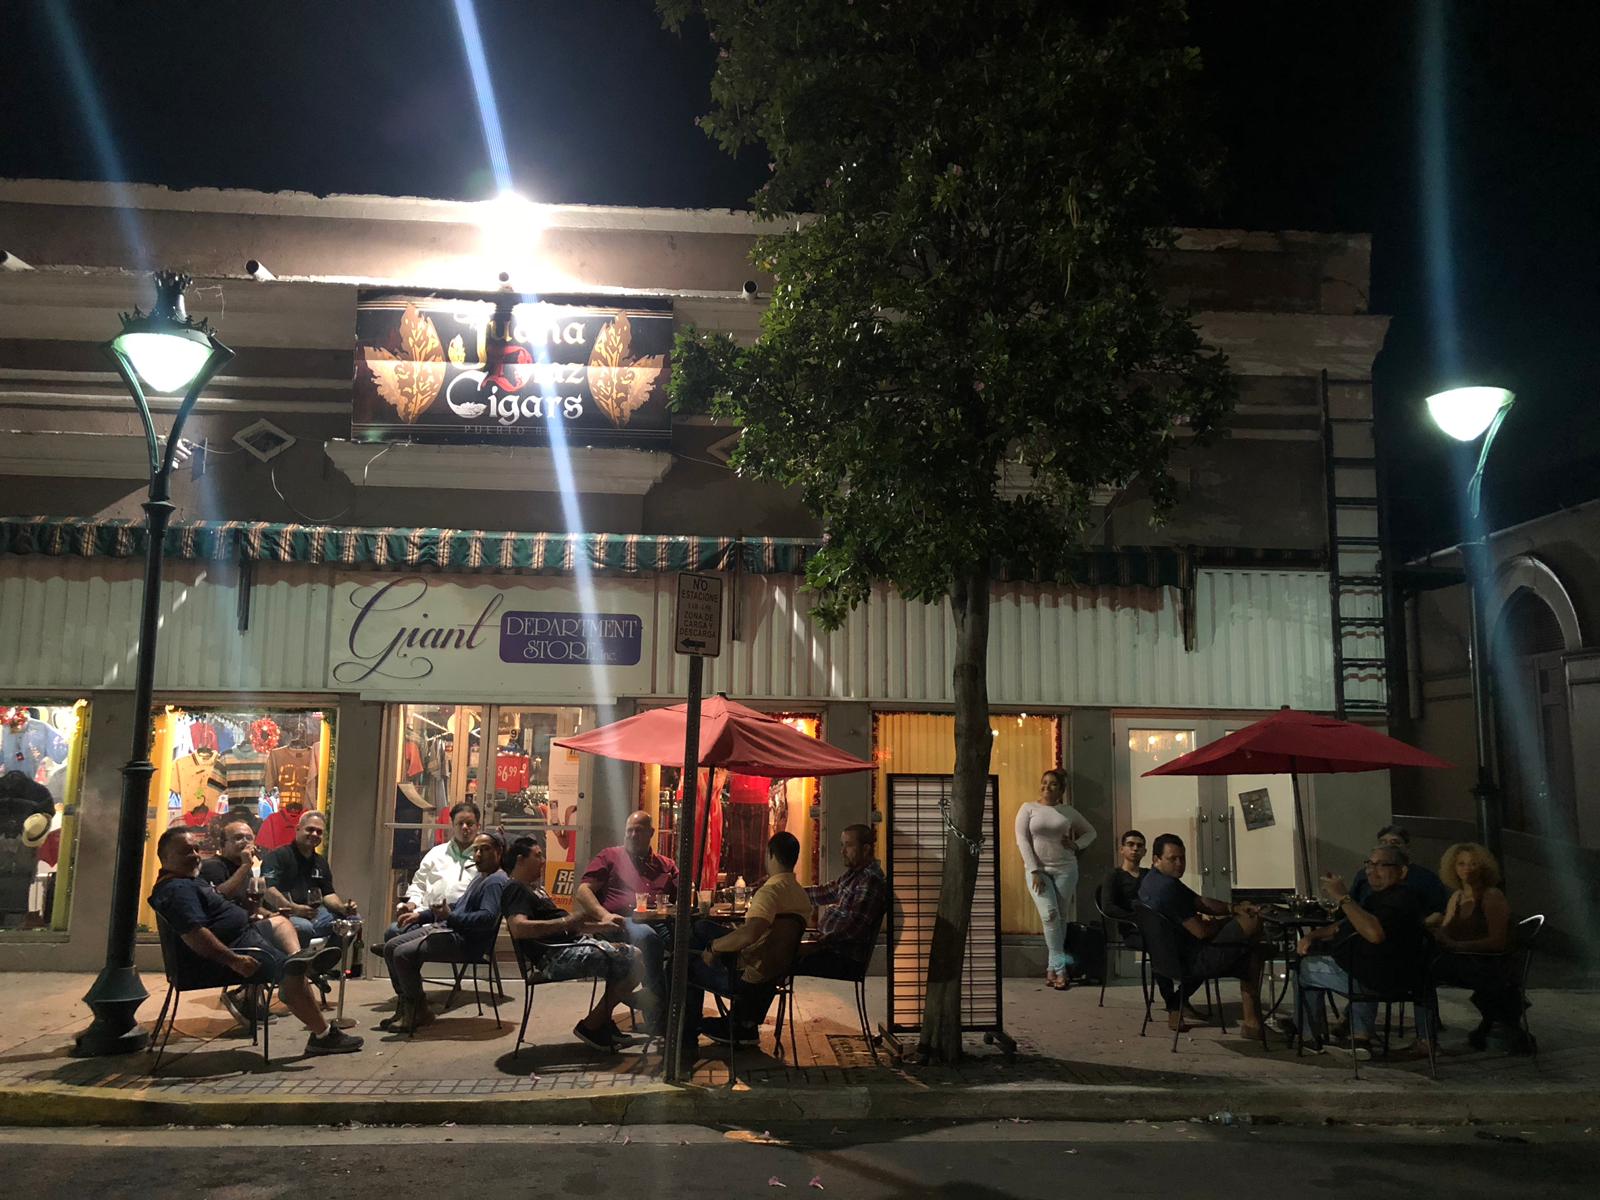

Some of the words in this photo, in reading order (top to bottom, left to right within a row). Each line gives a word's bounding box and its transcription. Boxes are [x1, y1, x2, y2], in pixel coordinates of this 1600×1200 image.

[446, 371, 584, 425] Cigars
[464, 424, 525, 436] PUERTO
[693, 579, 708, 592] NO
[333, 576, 504, 683] Giant
[506, 616, 638, 638] DEPARTMENT
[523, 639, 600, 660] STORE
